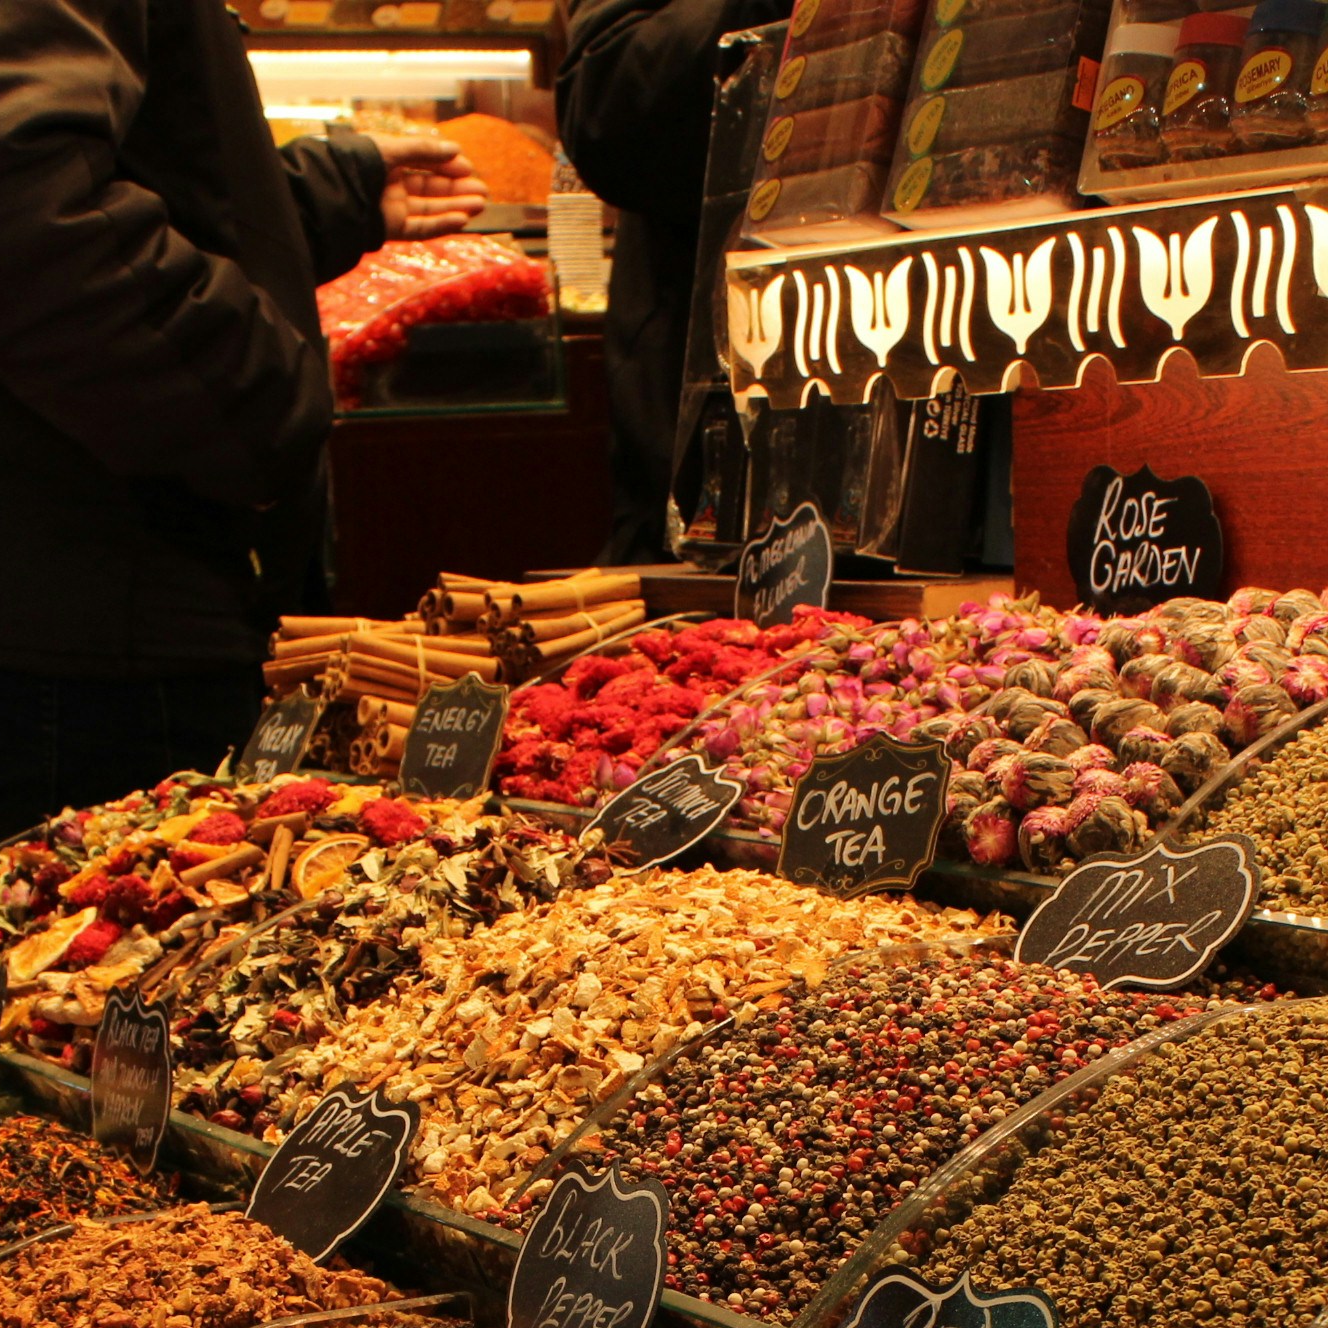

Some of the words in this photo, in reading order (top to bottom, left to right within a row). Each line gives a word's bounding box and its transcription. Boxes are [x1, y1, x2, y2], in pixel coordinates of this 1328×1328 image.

[1093, 476, 1178, 544] ROSE
[1090, 540, 1200, 593] GARDEN
[417, 707, 491, 734] ENERGY
[426, 743, 458, 768] TEA
[614, 796, 668, 829] TEA
[797, 772, 937, 831] ORANGE
[825, 824, 886, 867] TEA
[1041, 910, 1222, 970] PEPPER
[298, 1102, 392, 1158] APPLE
[272, 1155, 333, 1193] TEA
